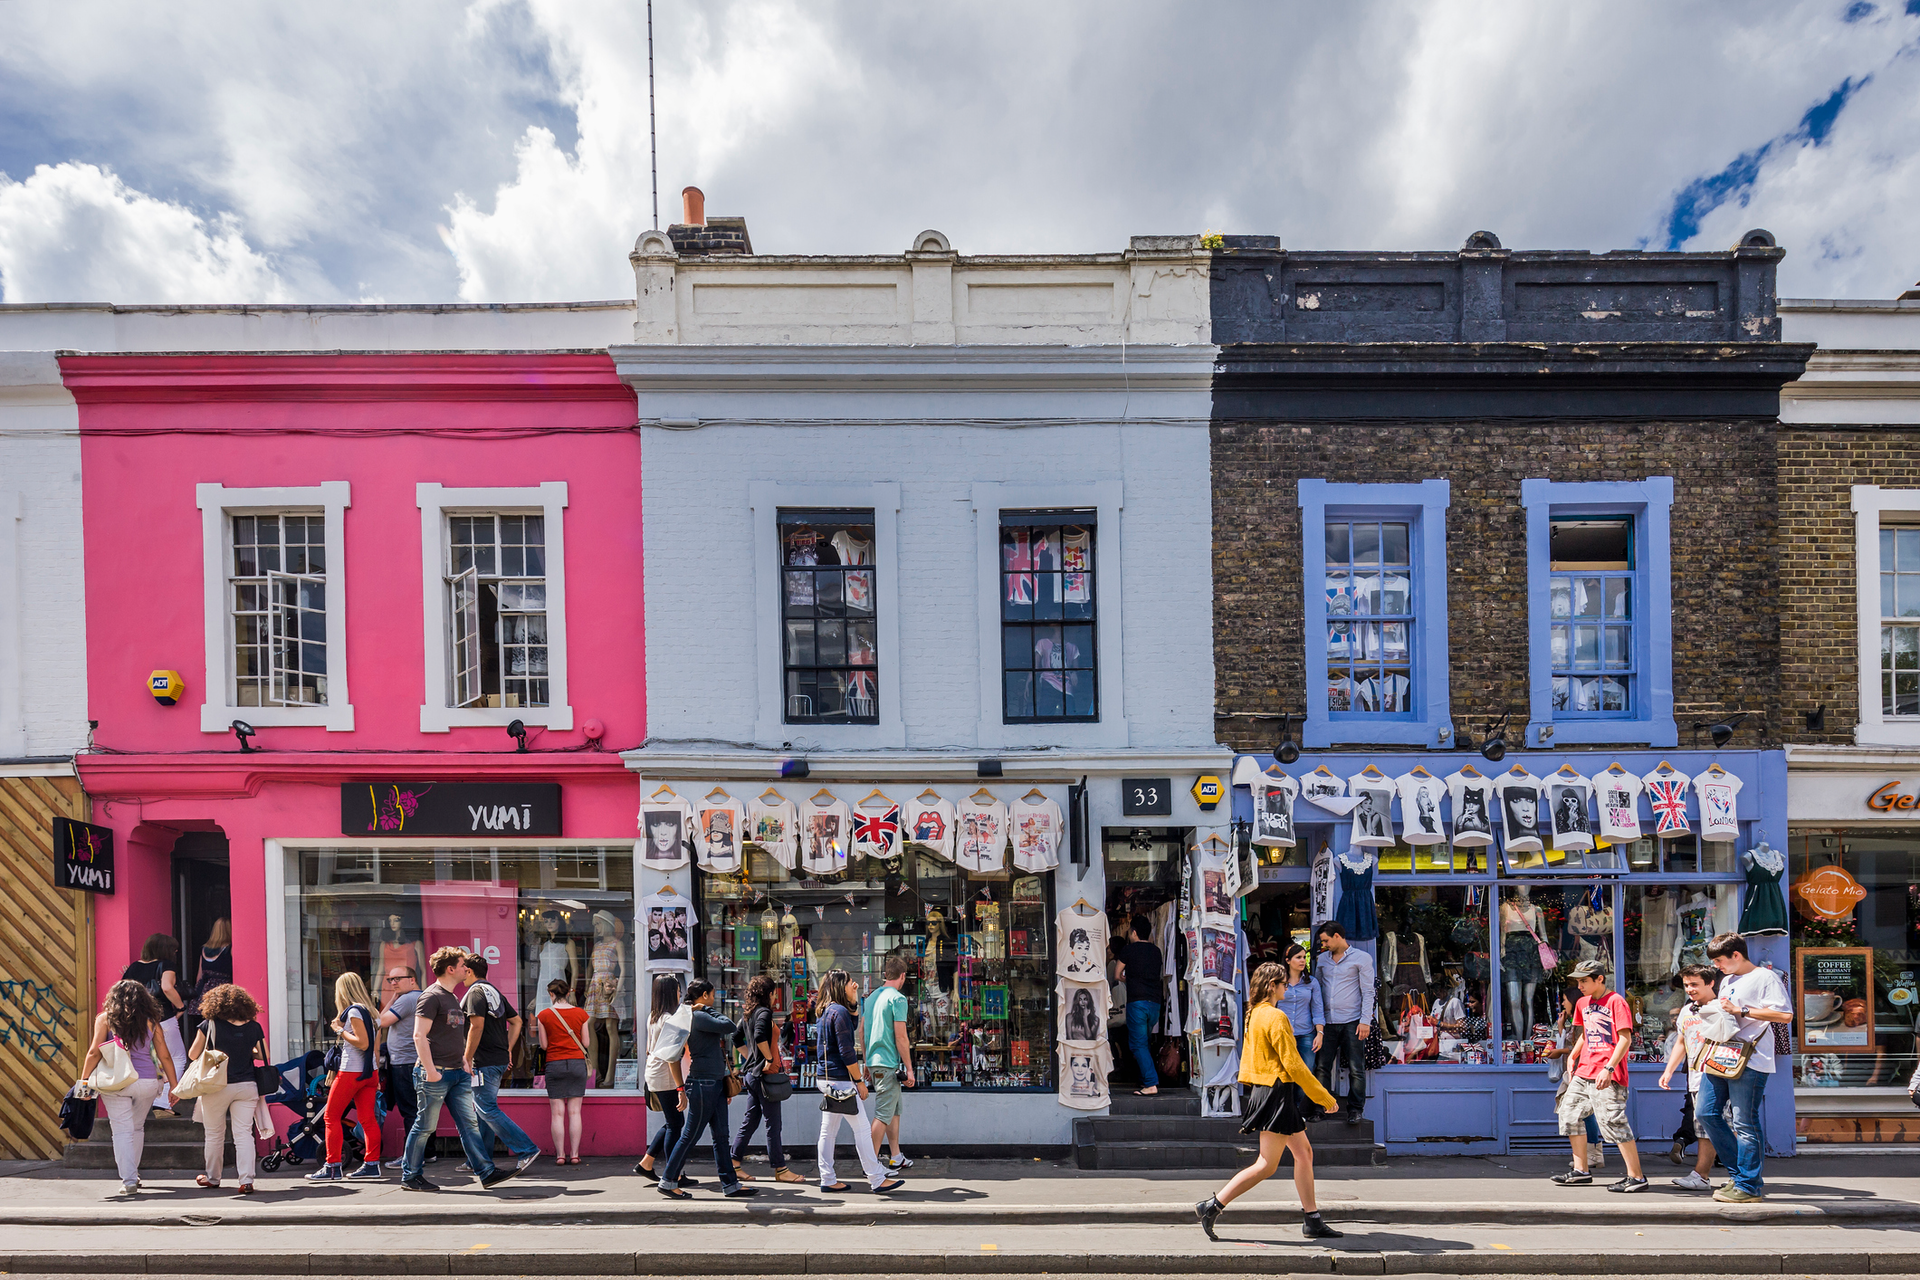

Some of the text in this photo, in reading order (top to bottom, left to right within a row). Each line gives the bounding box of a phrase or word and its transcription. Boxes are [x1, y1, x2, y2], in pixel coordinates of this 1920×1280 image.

[153, 679, 168, 687] ADT
[1201, 785, 1217, 794] ADT
[1133, 787, 1159, 806] 33
[1866, 780, 1920, 812] Ge
[1261, 812, 1288, 823] FUCK
[1801, 883, 1864, 896] Gelato Mio
[1817, 961, 1852, 969] COFFEE
